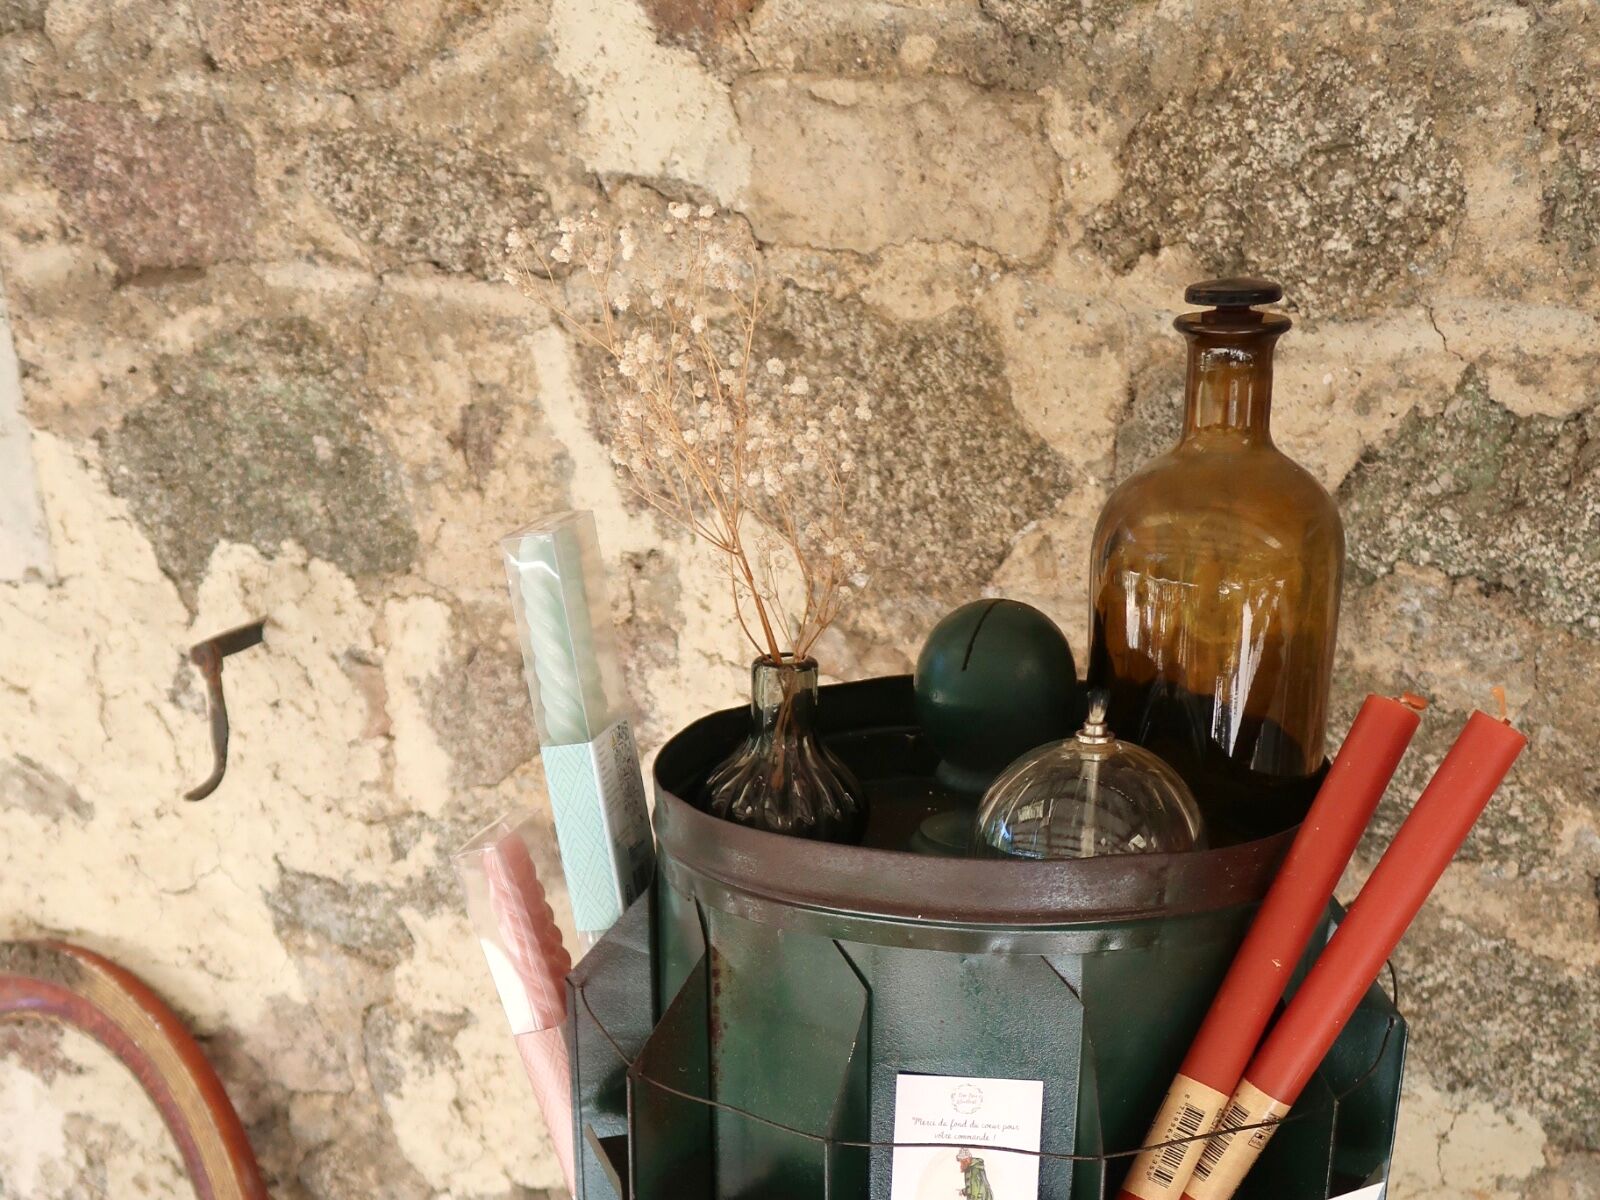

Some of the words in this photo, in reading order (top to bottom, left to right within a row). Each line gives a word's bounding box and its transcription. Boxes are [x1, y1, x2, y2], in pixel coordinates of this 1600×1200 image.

[949, 1119, 968, 1131] fond
[934, 1131, 952, 1140] votre
[953, 1133, 991, 1142] commande
